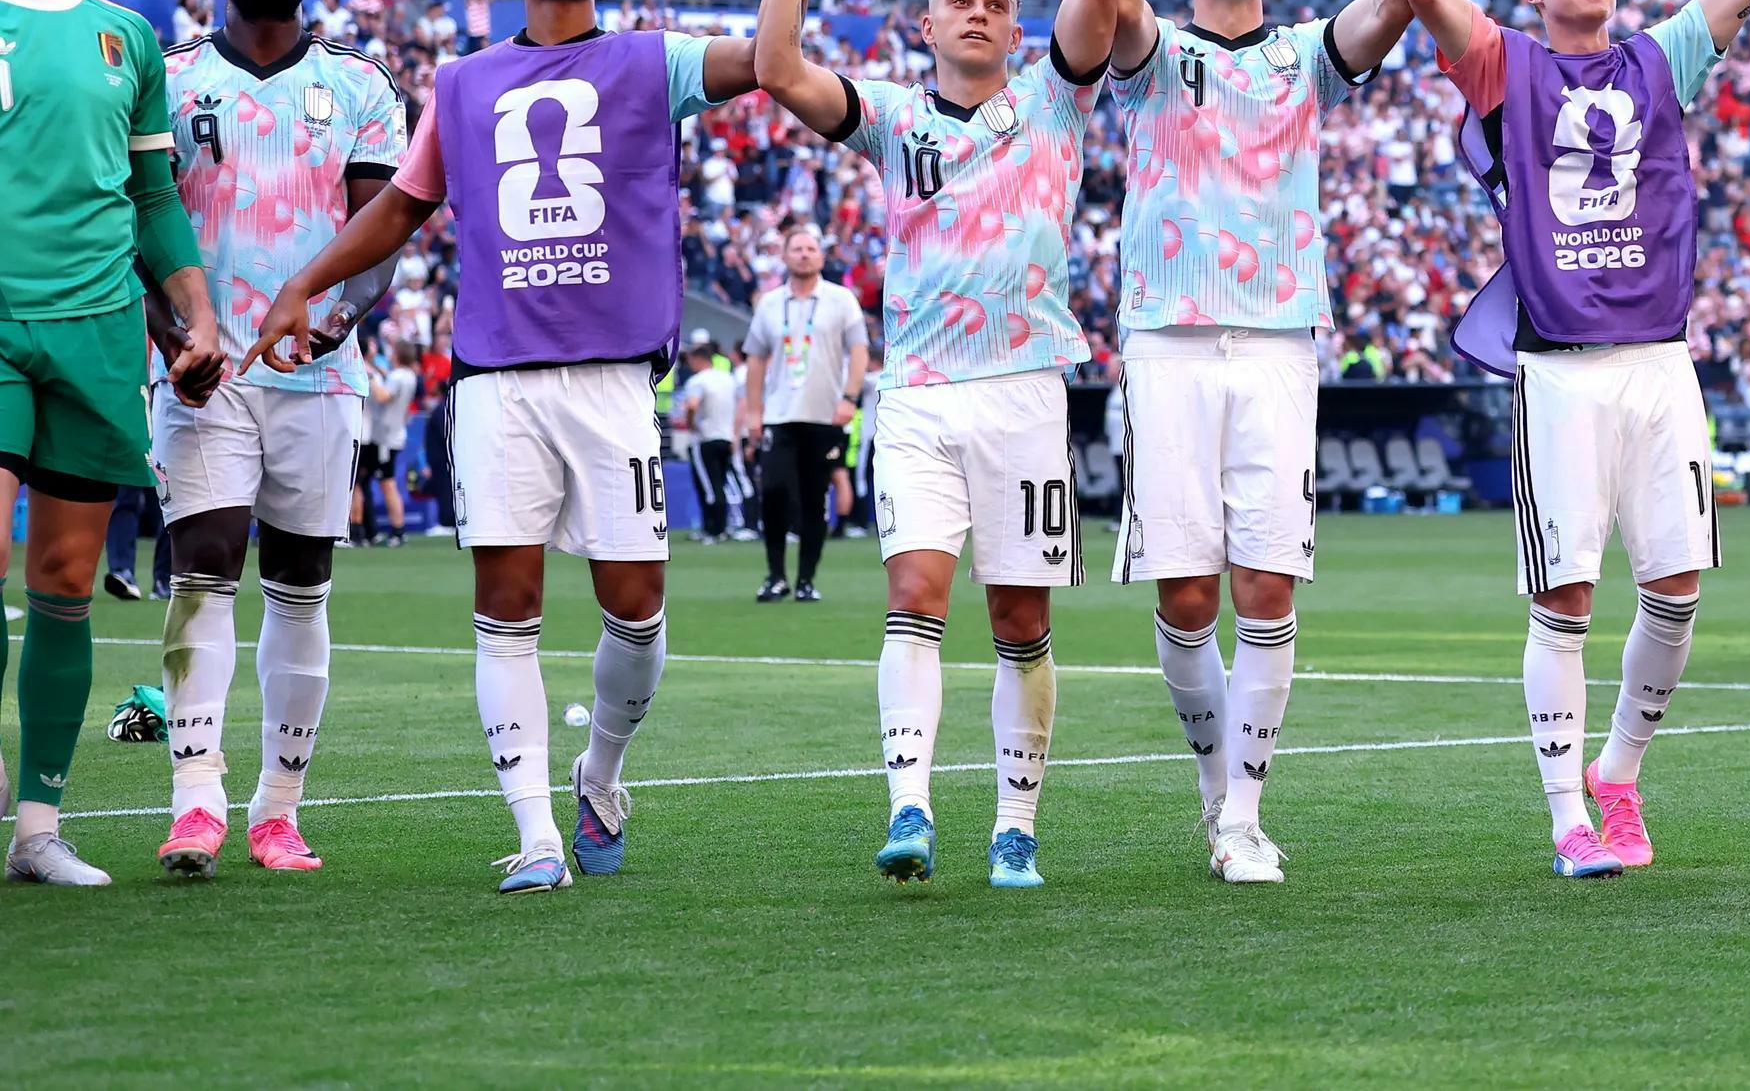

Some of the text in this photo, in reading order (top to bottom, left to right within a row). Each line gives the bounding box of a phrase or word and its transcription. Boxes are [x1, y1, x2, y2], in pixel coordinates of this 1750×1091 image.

[1180, 59, 1205, 108] 4
[191, 113, 224, 164] 9
[902, 142, 942, 201] 10
[1579, 190, 1619, 210] FIFA
[529, 205, 578, 225] FIFA
[1552, 227, 1643, 246] WORLD CUP
[501, 243, 609, 264] WORLD CUP
[1555, 245, 1646, 271] 2026
[502, 261, 611, 290] 2026
[629, 456, 664, 514] 16
[1020, 479, 1066, 537] 10
[167, 716, 213, 729] RBFA
[1532, 712, 1574, 723] RBFA
[1003, 748, 1045, 761] RBFA
